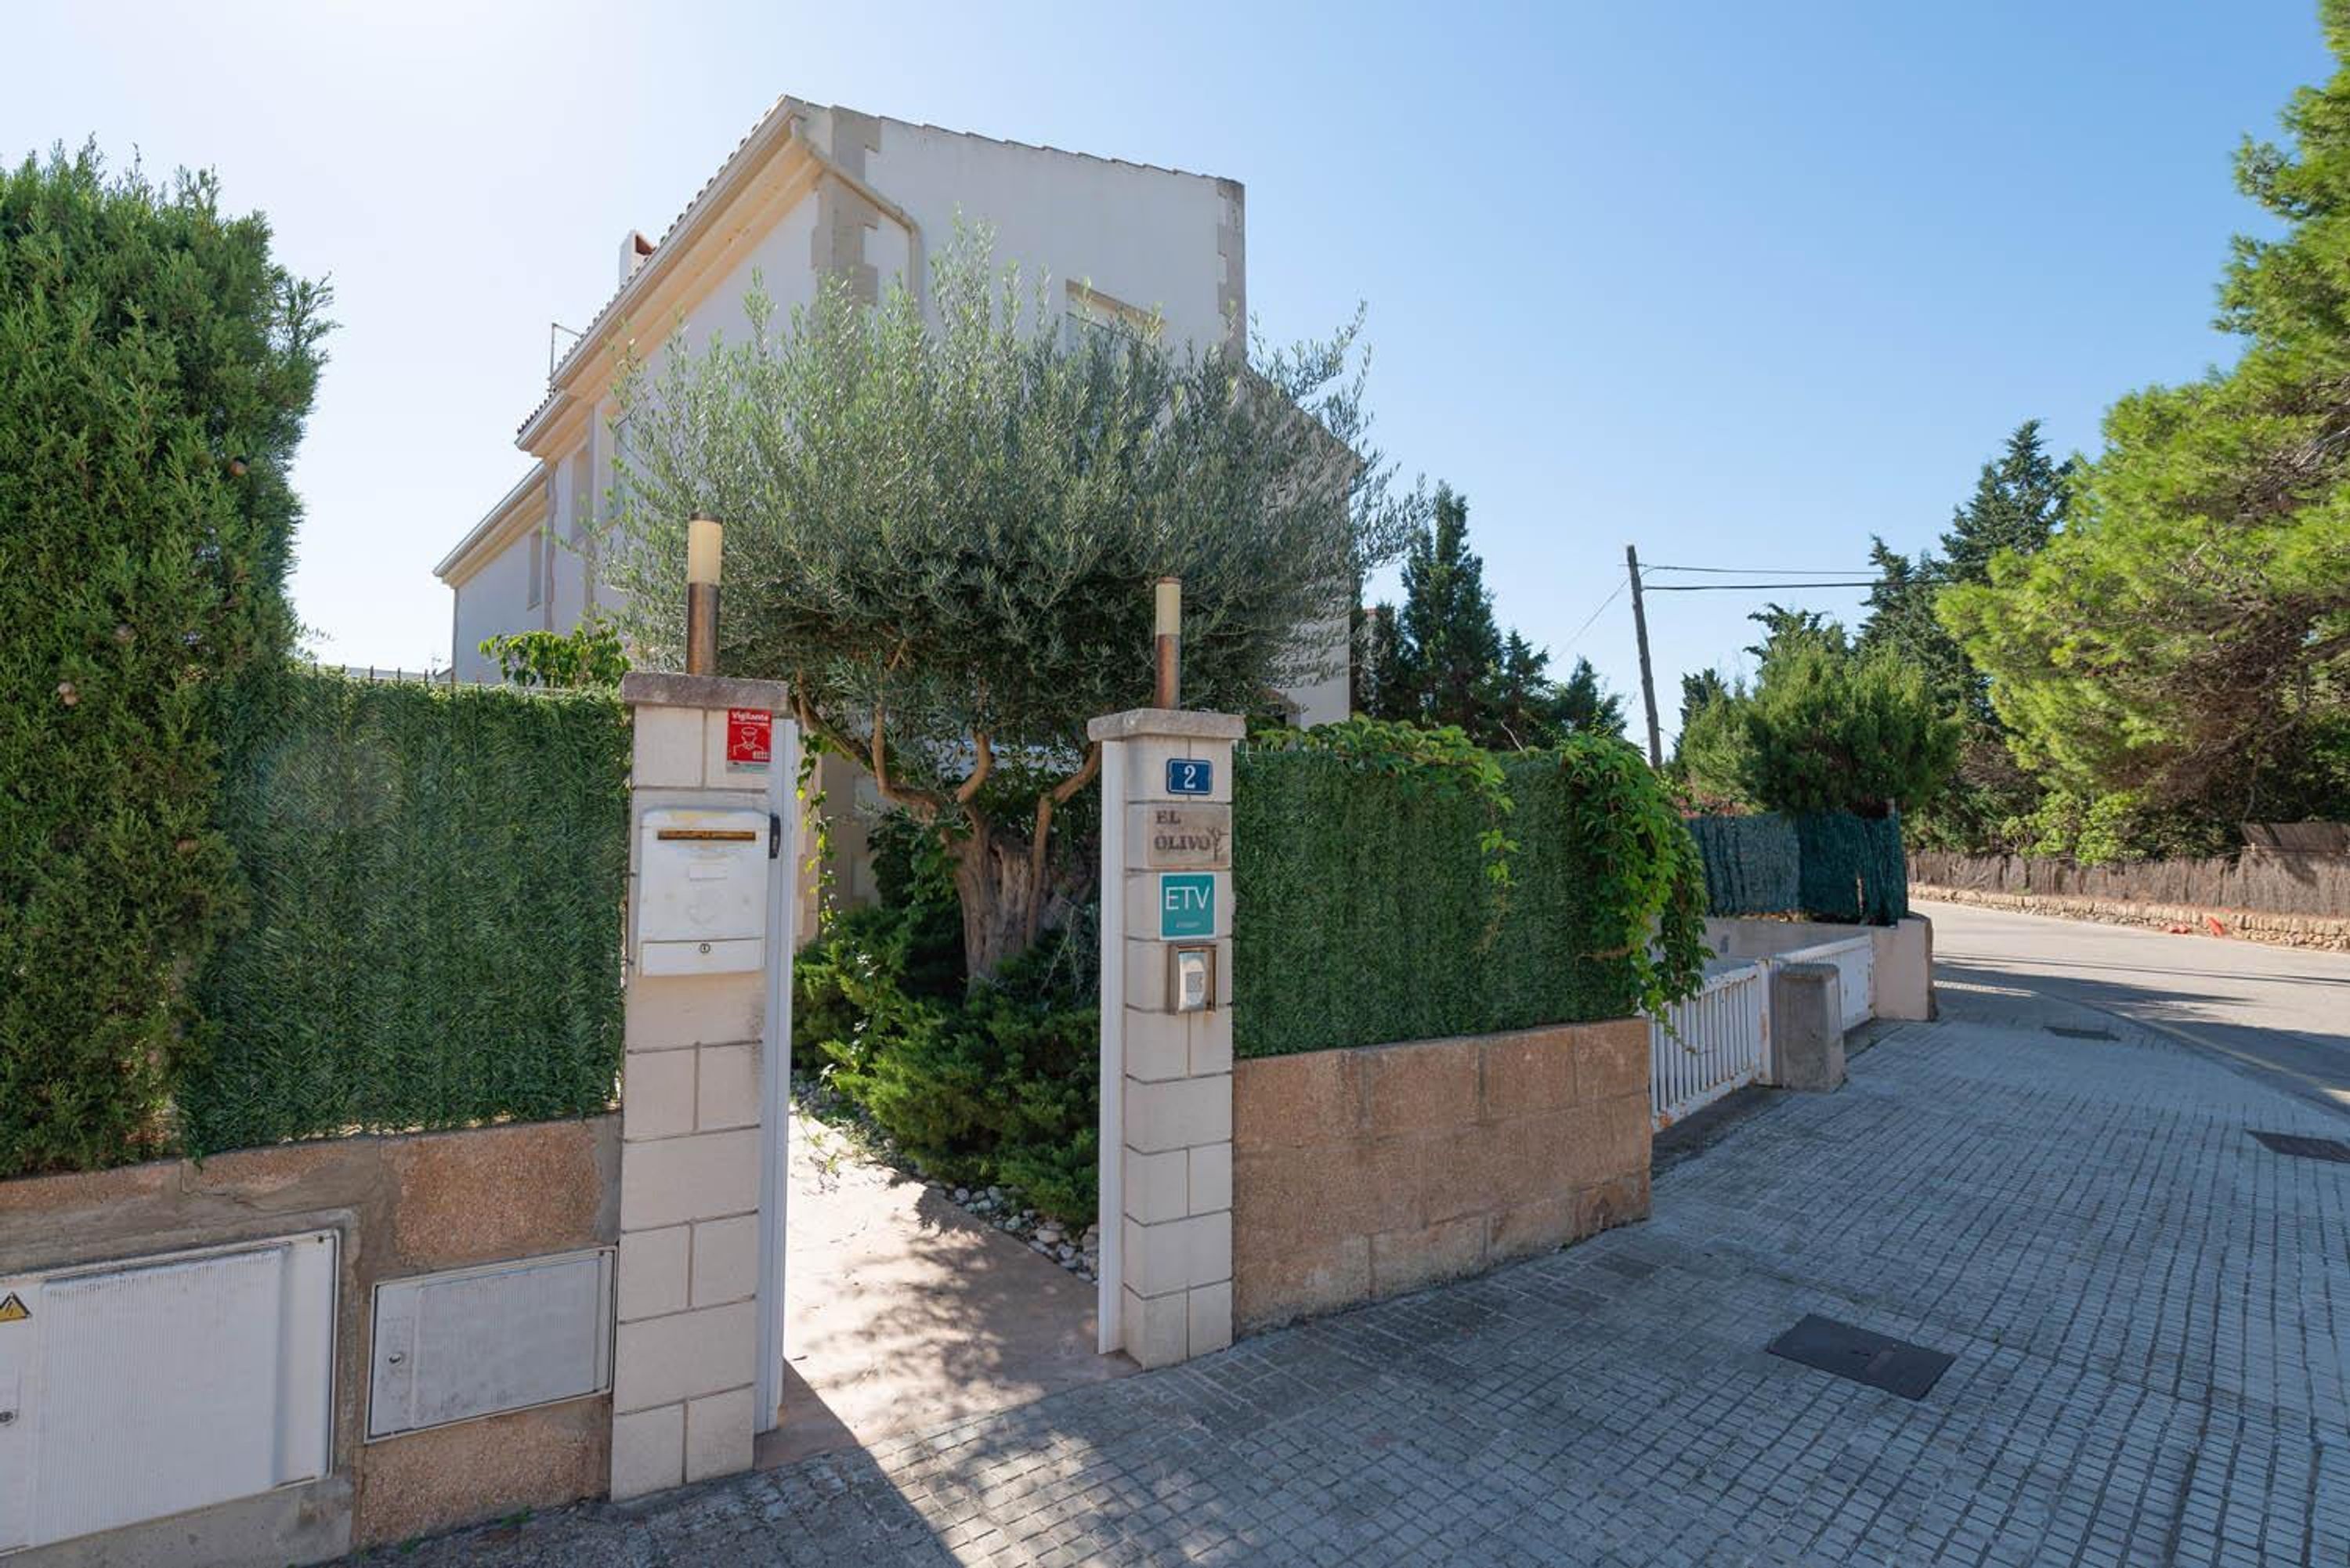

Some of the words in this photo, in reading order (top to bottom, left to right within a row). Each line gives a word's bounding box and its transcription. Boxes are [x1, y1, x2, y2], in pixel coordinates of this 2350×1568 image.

[1184, 764, 1195, 789] 2
[1156, 810, 1180, 824] EL
[1154, 835, 1210, 851] OLIVO
[1166, 886, 1210, 910] ETV
